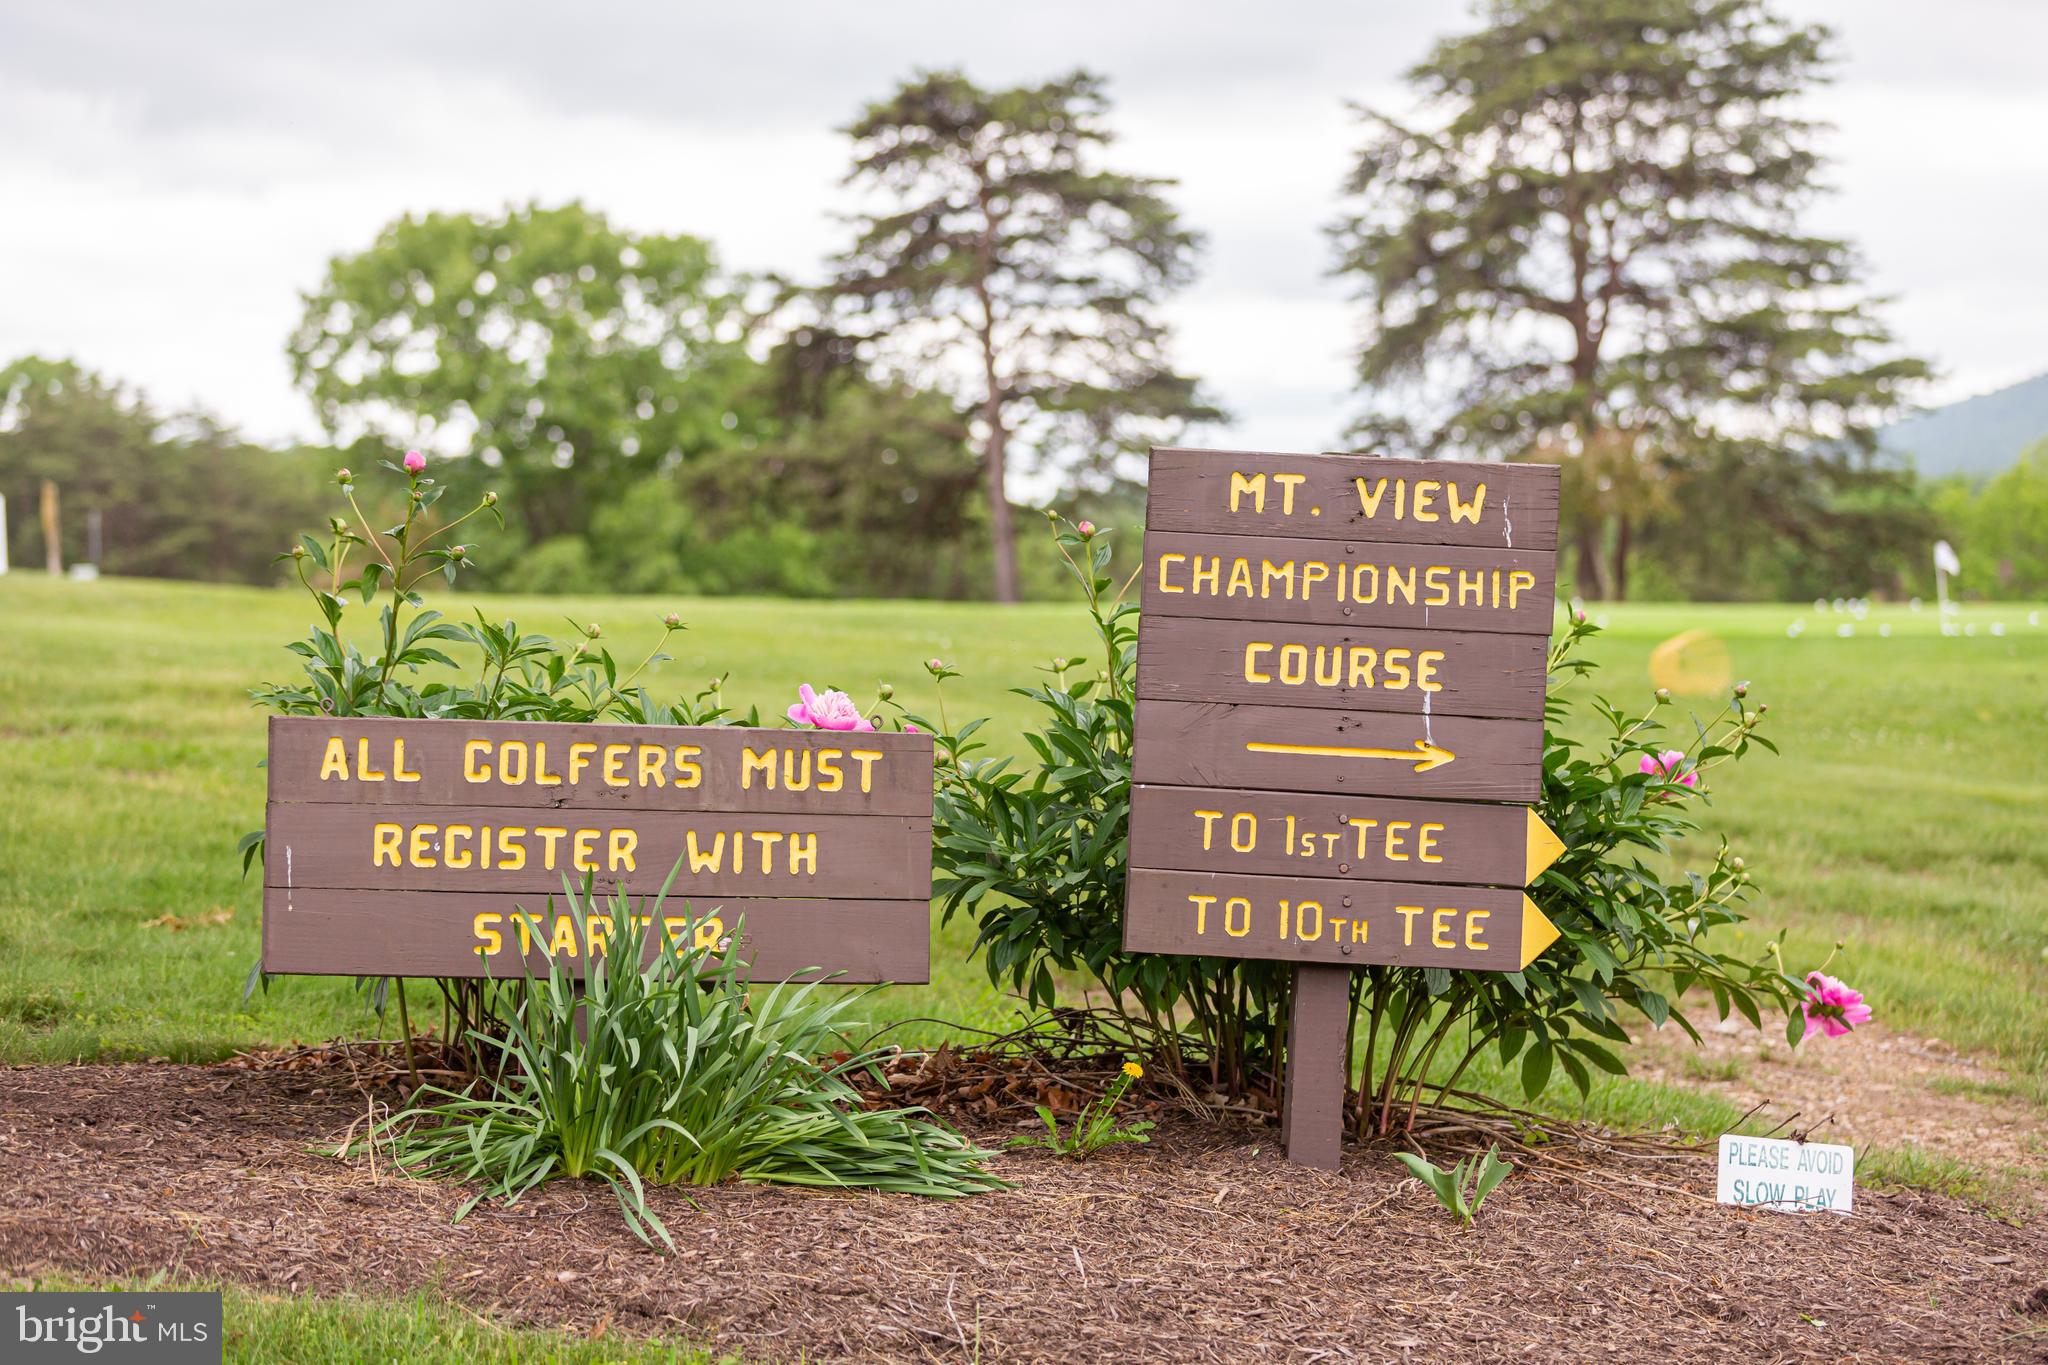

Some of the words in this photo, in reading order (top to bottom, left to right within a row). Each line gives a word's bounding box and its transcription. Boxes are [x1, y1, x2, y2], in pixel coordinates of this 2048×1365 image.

[1229, 471, 1322, 517] MT.
[1355, 477, 1488, 525] VIEW
[1158, 553, 1537, 610] CHAMPIONSHIP
[1244, 642, 1446, 692] COURSE
[319, 737, 422, 783] ALL
[463, 740, 703, 789] GOLFERS
[741, 747, 885, 793] MUST
[373, 823, 639, 873] REGISTER
[686, 830, 818, 876] WITH
[1193, 809, 1258, 854] TO
[1347, 818, 1447, 864] TEE
[1187, 893, 1253, 939] TO
[1395, 905, 1492, 952] TEE
[1728, 1142, 1790, 1170] PLEASE
[1797, 1149, 1844, 1175] AVOID
[1733, 1178, 1786, 1206] SLOW
[1794, 1185, 1838, 1210] PLAY
